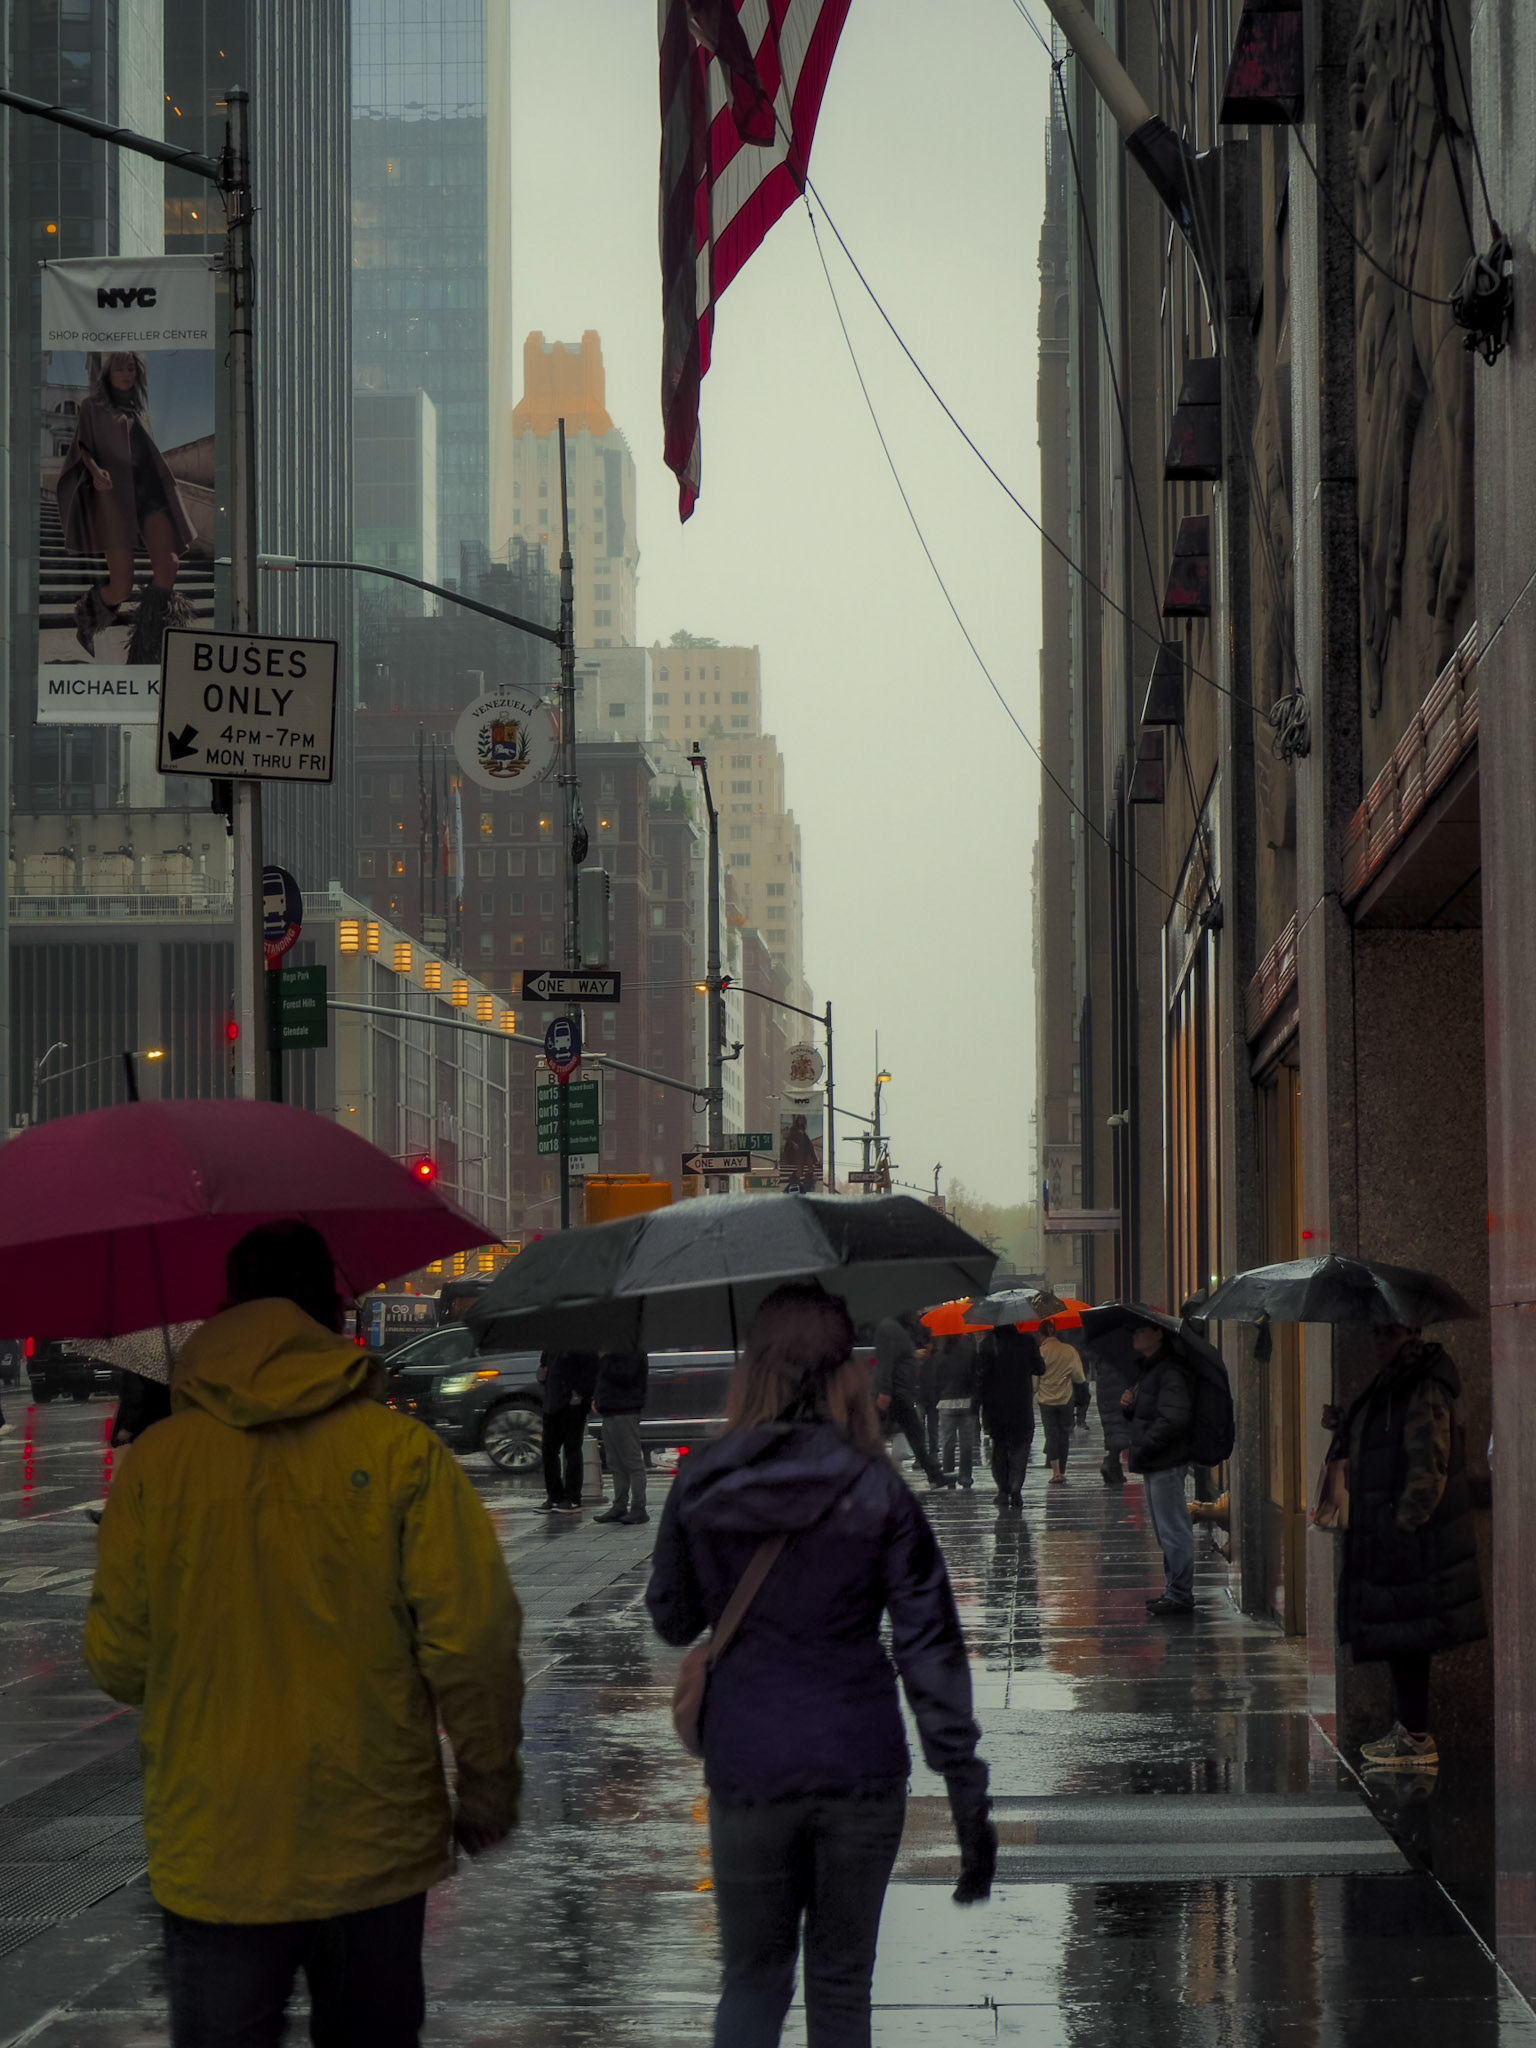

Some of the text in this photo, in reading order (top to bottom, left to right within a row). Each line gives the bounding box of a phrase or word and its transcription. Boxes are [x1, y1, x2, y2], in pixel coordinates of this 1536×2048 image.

[97, 287, 157, 309] NYC
[49, 329, 208, 342] SHOP ROCKEFELLER CENTER
[193, 641, 307, 679] BUSES
[49, 680, 139, 696] MICHAEL
[203, 683, 294, 718] ONLY
[472, 699, 534, 718] VENEZUELA
[206, 748, 326, 771] MON THRU FRI
[264, 928, 297, 955] STANDING
[283, 971, 310, 983] Rego Park
[537, 979, 608, 993] ONE WAY
[283, 998, 316, 1010] Forest Hills
[283, 1025, 309, 1037] Glendale
[538, 1087, 559, 1102] QM15
[538, 1104, 559, 1119] QM16
[538, 1121, 559, 1136] QM17
[538, 1138, 559, 1153] QM18
[738, 1135, 771, 1149] W 51 St
[694, 1158, 744, 1168] ONE WAY
[760, 1177, 781, 1187] W 52
